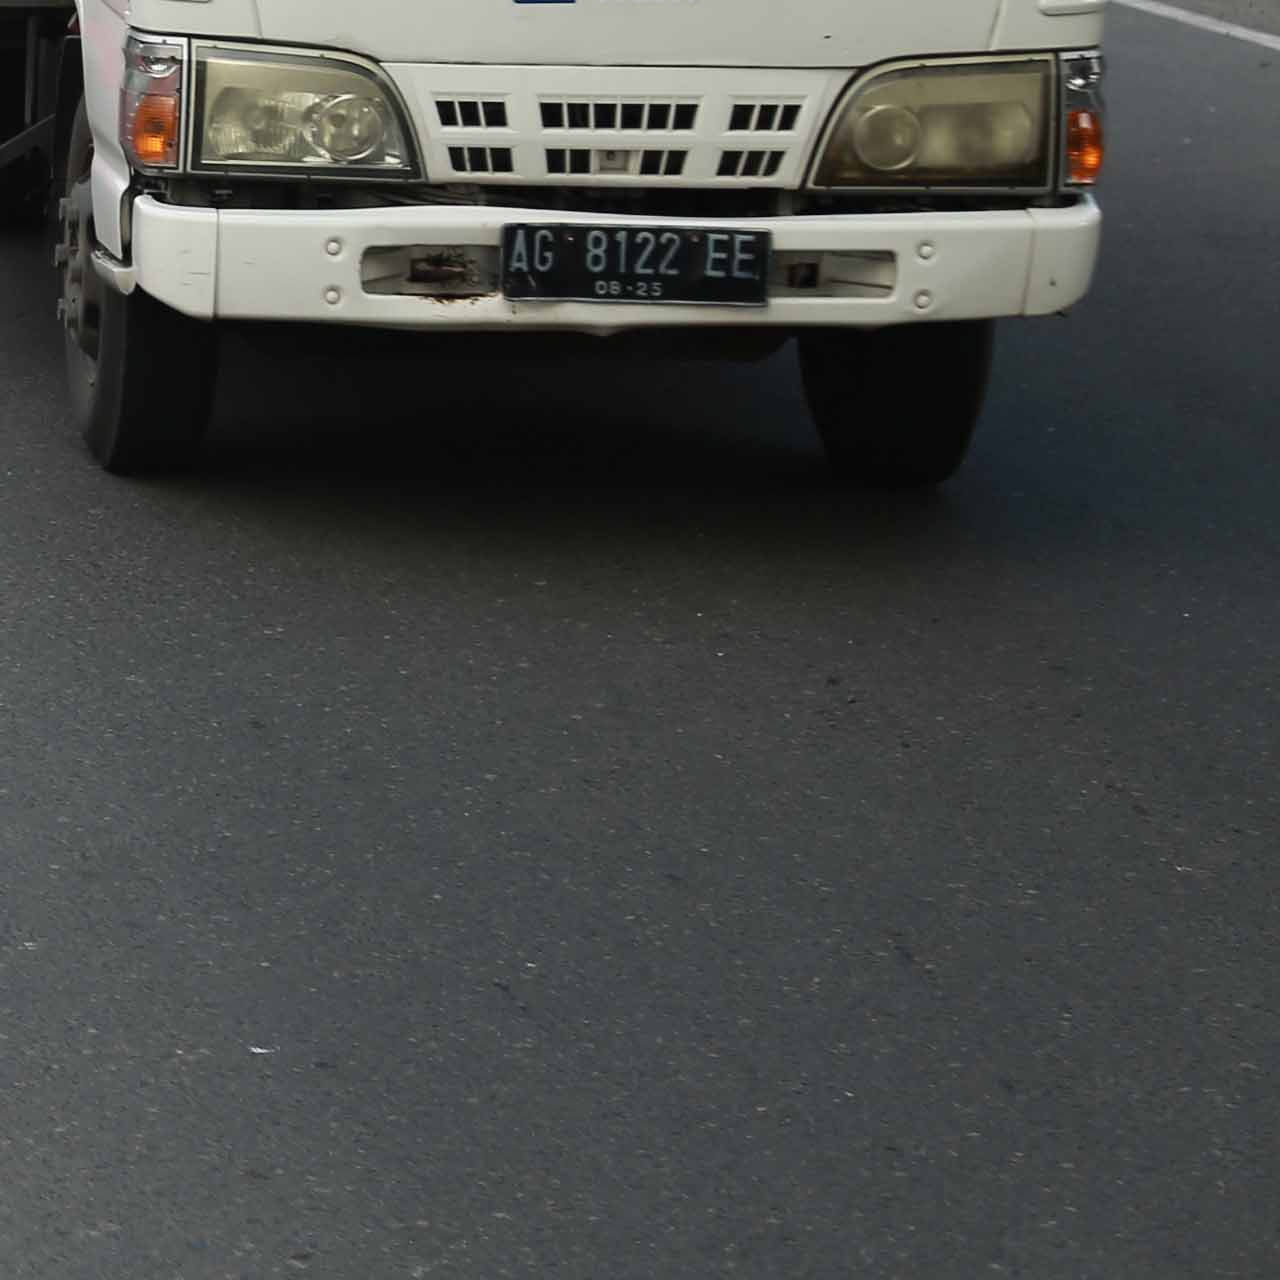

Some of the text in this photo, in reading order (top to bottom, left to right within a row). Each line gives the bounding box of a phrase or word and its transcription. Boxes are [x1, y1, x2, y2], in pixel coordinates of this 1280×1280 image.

[509, 229, 756, 279] AG 8122 EE
